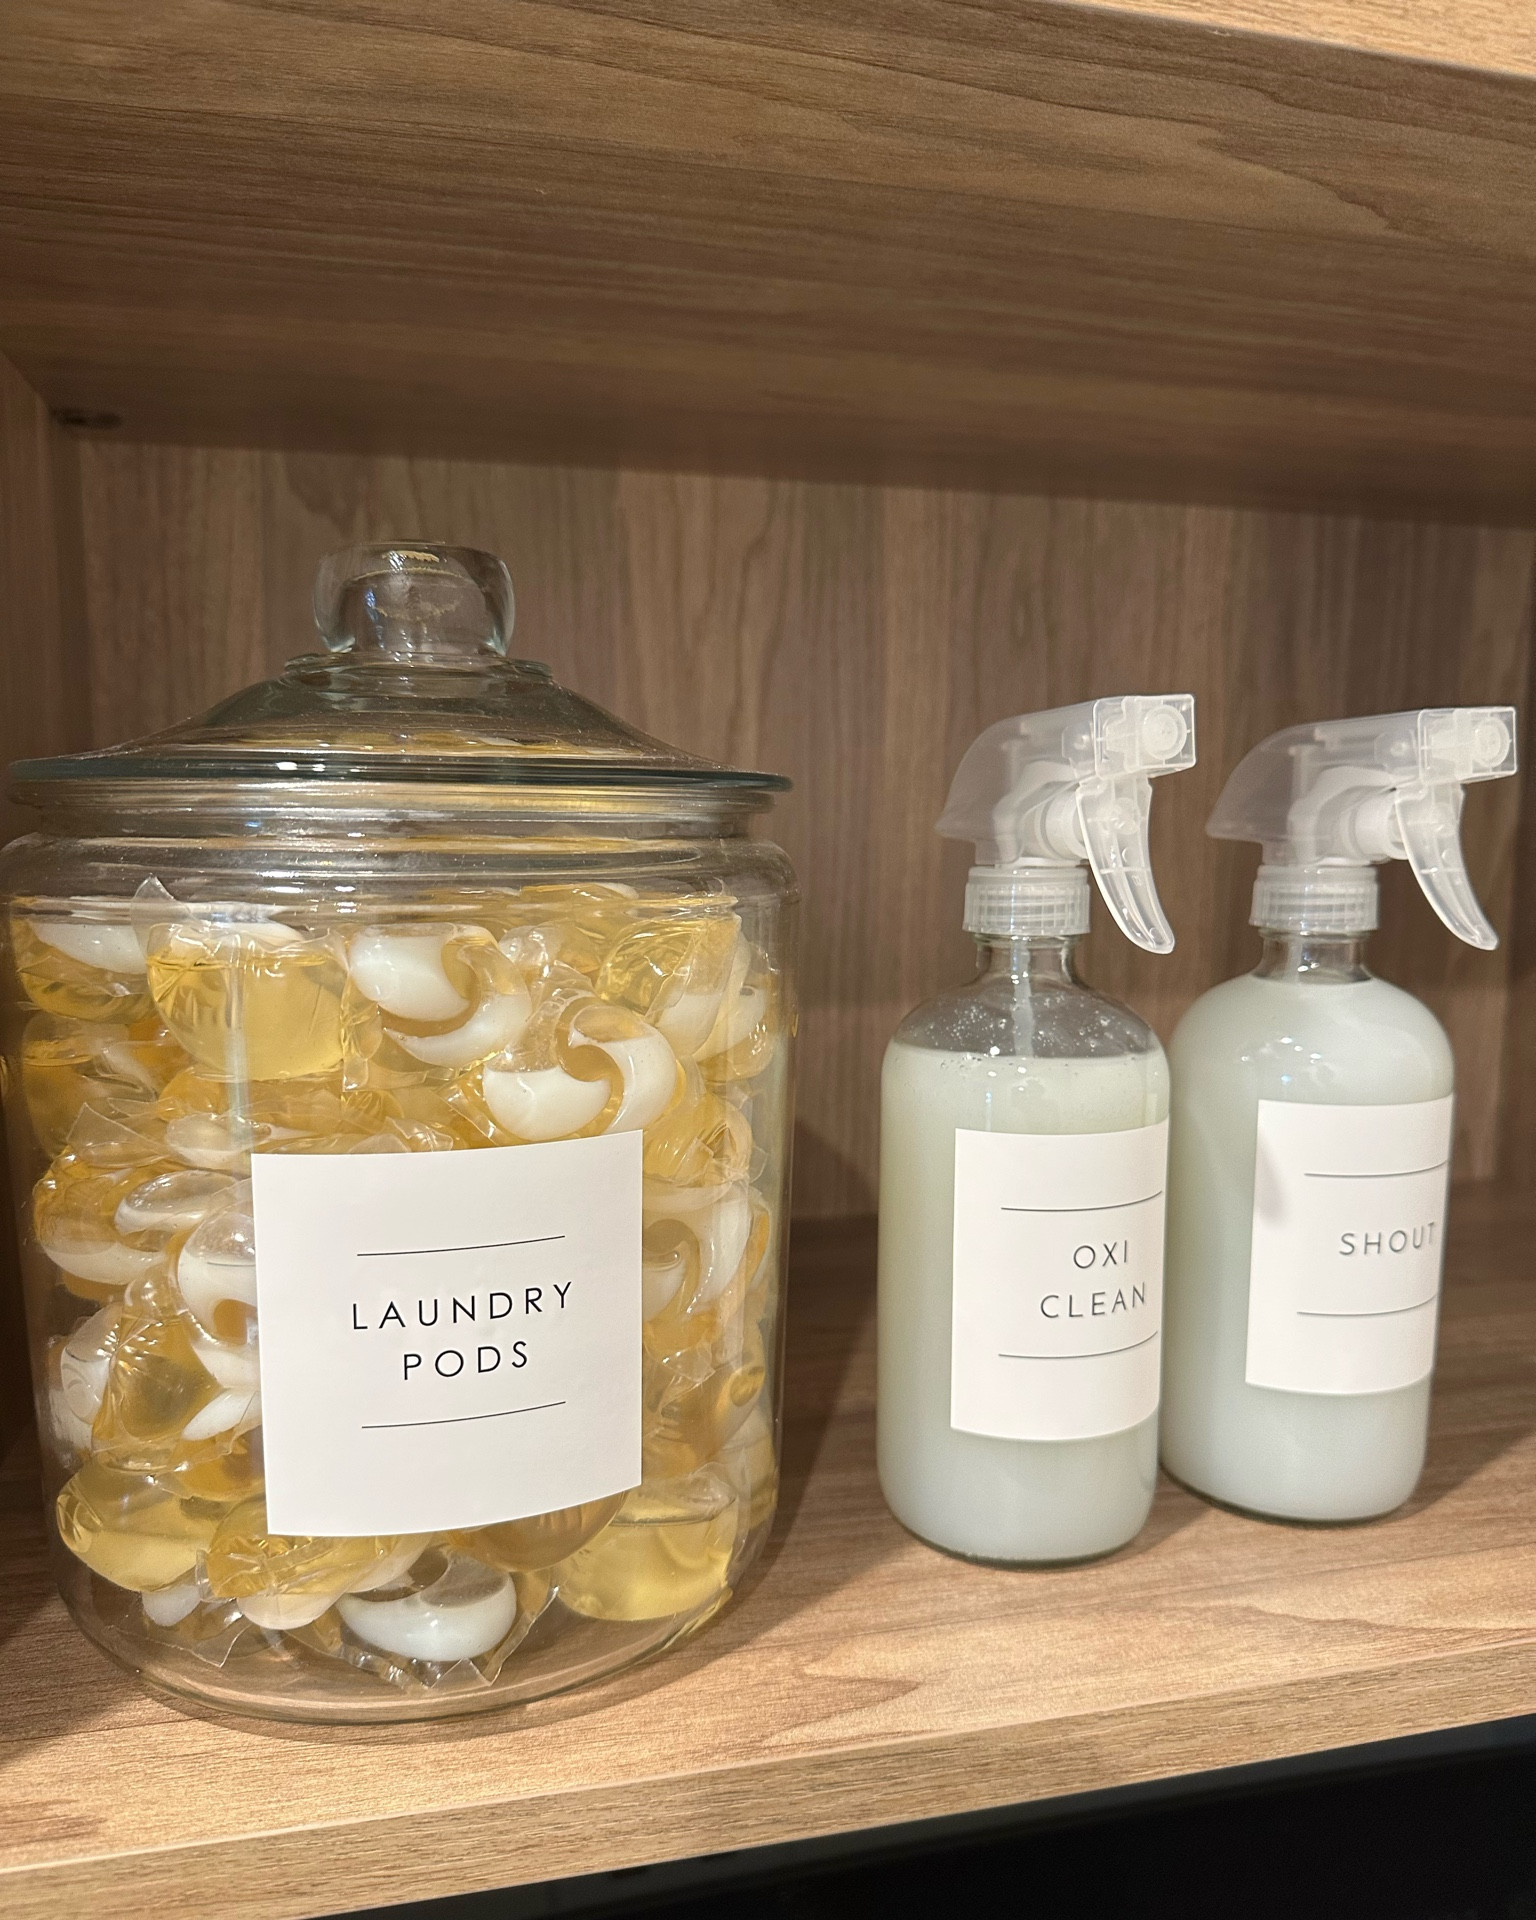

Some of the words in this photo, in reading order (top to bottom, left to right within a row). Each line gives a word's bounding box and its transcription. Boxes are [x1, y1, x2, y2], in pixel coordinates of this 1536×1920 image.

[1072, 1239, 1129, 1270] OXI
[1339, 1222, 1436, 1255] SHOUT
[352, 1281, 572, 1330] LAUNDRY
[1040, 1281, 1147, 1319] CLEAN
[403, 1340, 528, 1381] PODS
